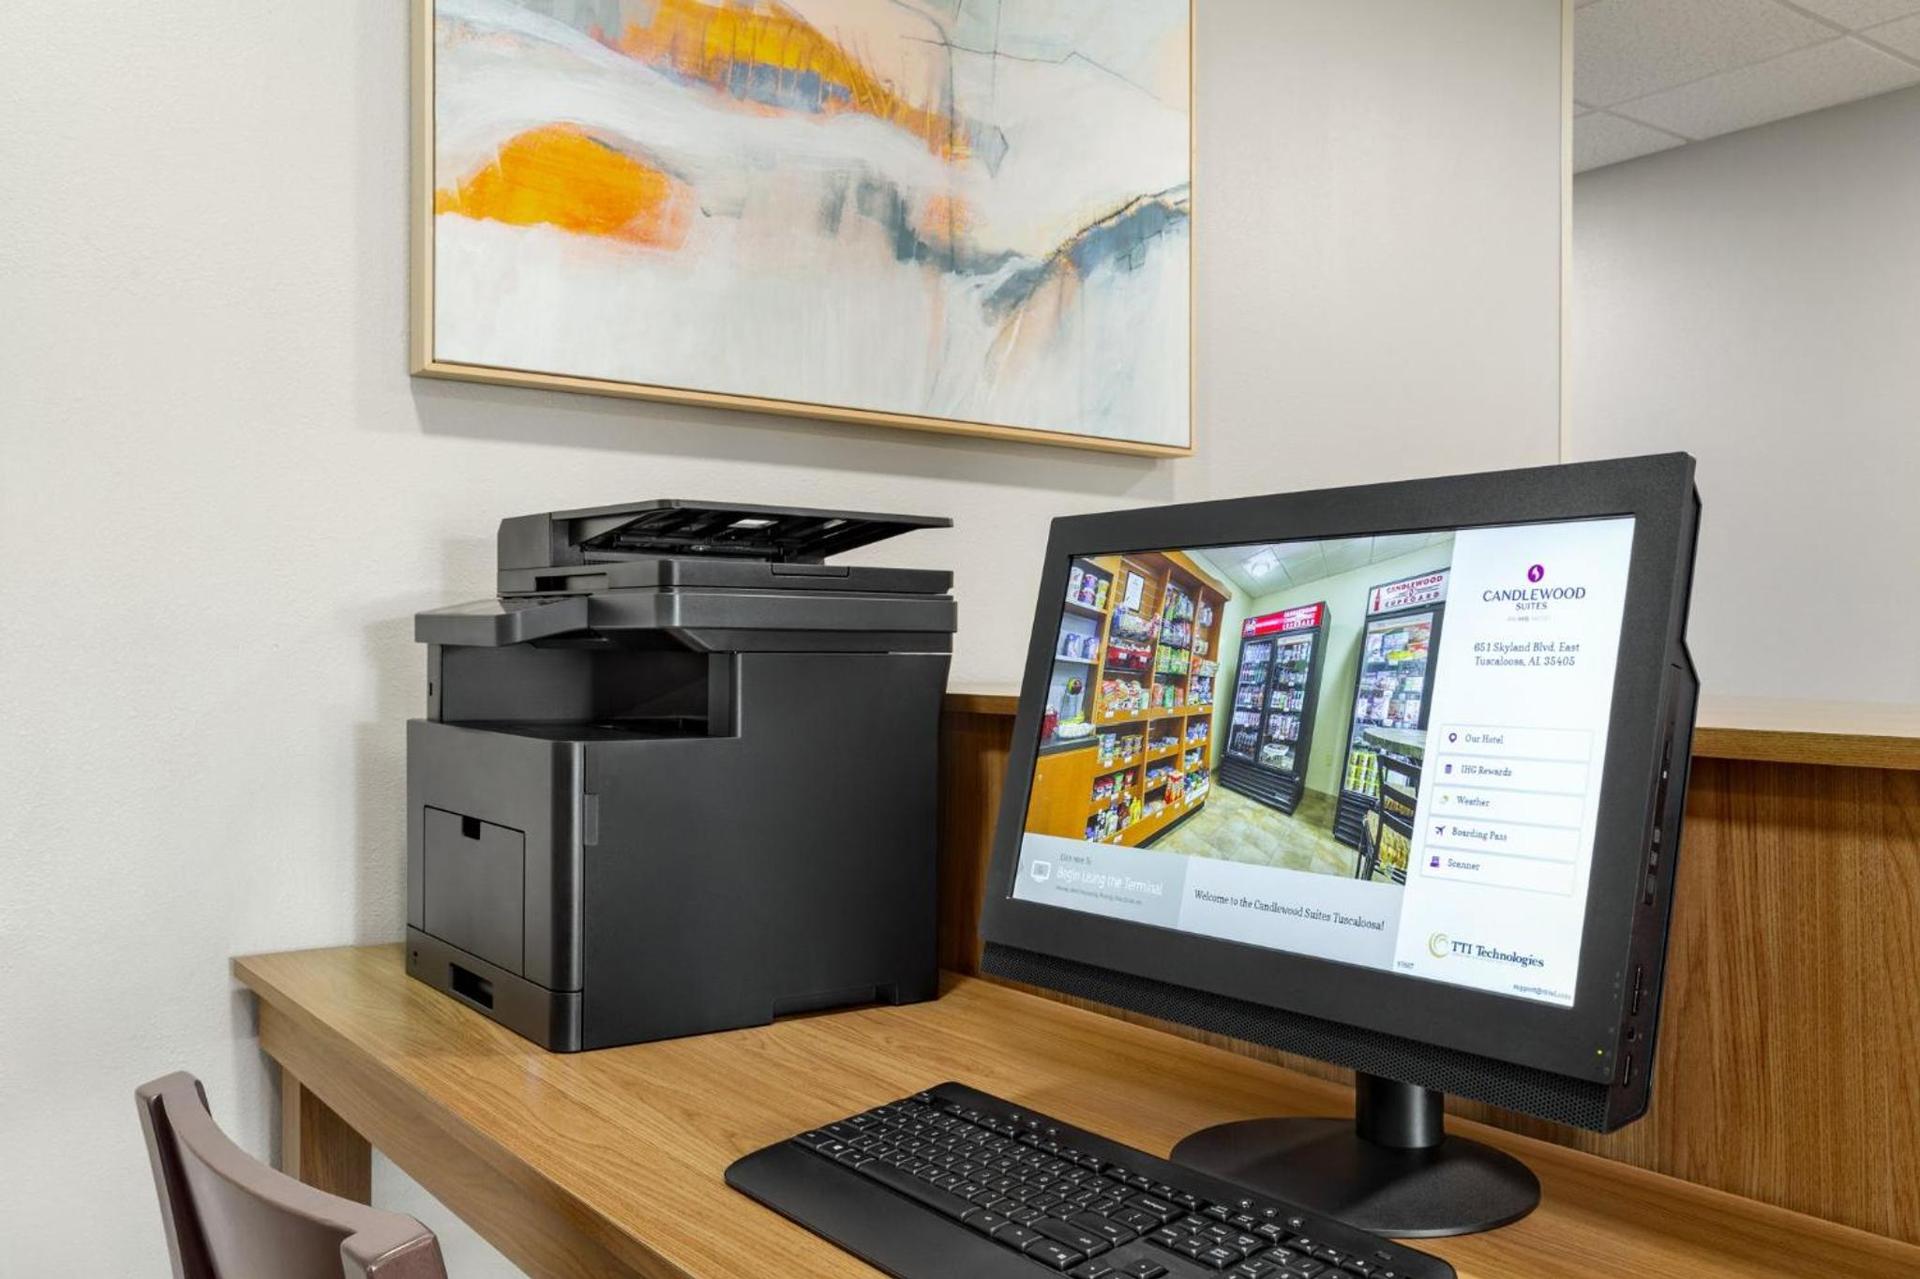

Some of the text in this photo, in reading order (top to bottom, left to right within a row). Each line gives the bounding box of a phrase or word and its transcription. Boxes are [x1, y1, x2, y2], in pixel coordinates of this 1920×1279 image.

[1482, 587, 1586, 602] CANDLEWOOD
[1515, 602, 1548, 611] SUITES
[1474, 642, 1491, 652] 651
[1493, 641, 1531, 655] Skyland
[1559, 641, 1580, 652] East
[1528, 656, 1541, 666] AL
[1544, 656, 1575, 667] 35405
[1465, 734, 1504, 745] Our Hotel
[1461, 764, 1512, 777] IHG Rewards
[1457, 795, 1490, 807] Weather
[1452, 826, 1508, 841] Boarding Pass
[1448, 857, 1481, 871] Scanner
[1194, 889, 1385, 932] Welcome to the Candlewood Suites Tuscaloosa!
[1451, 940, 1545, 968] TTI Technologies
